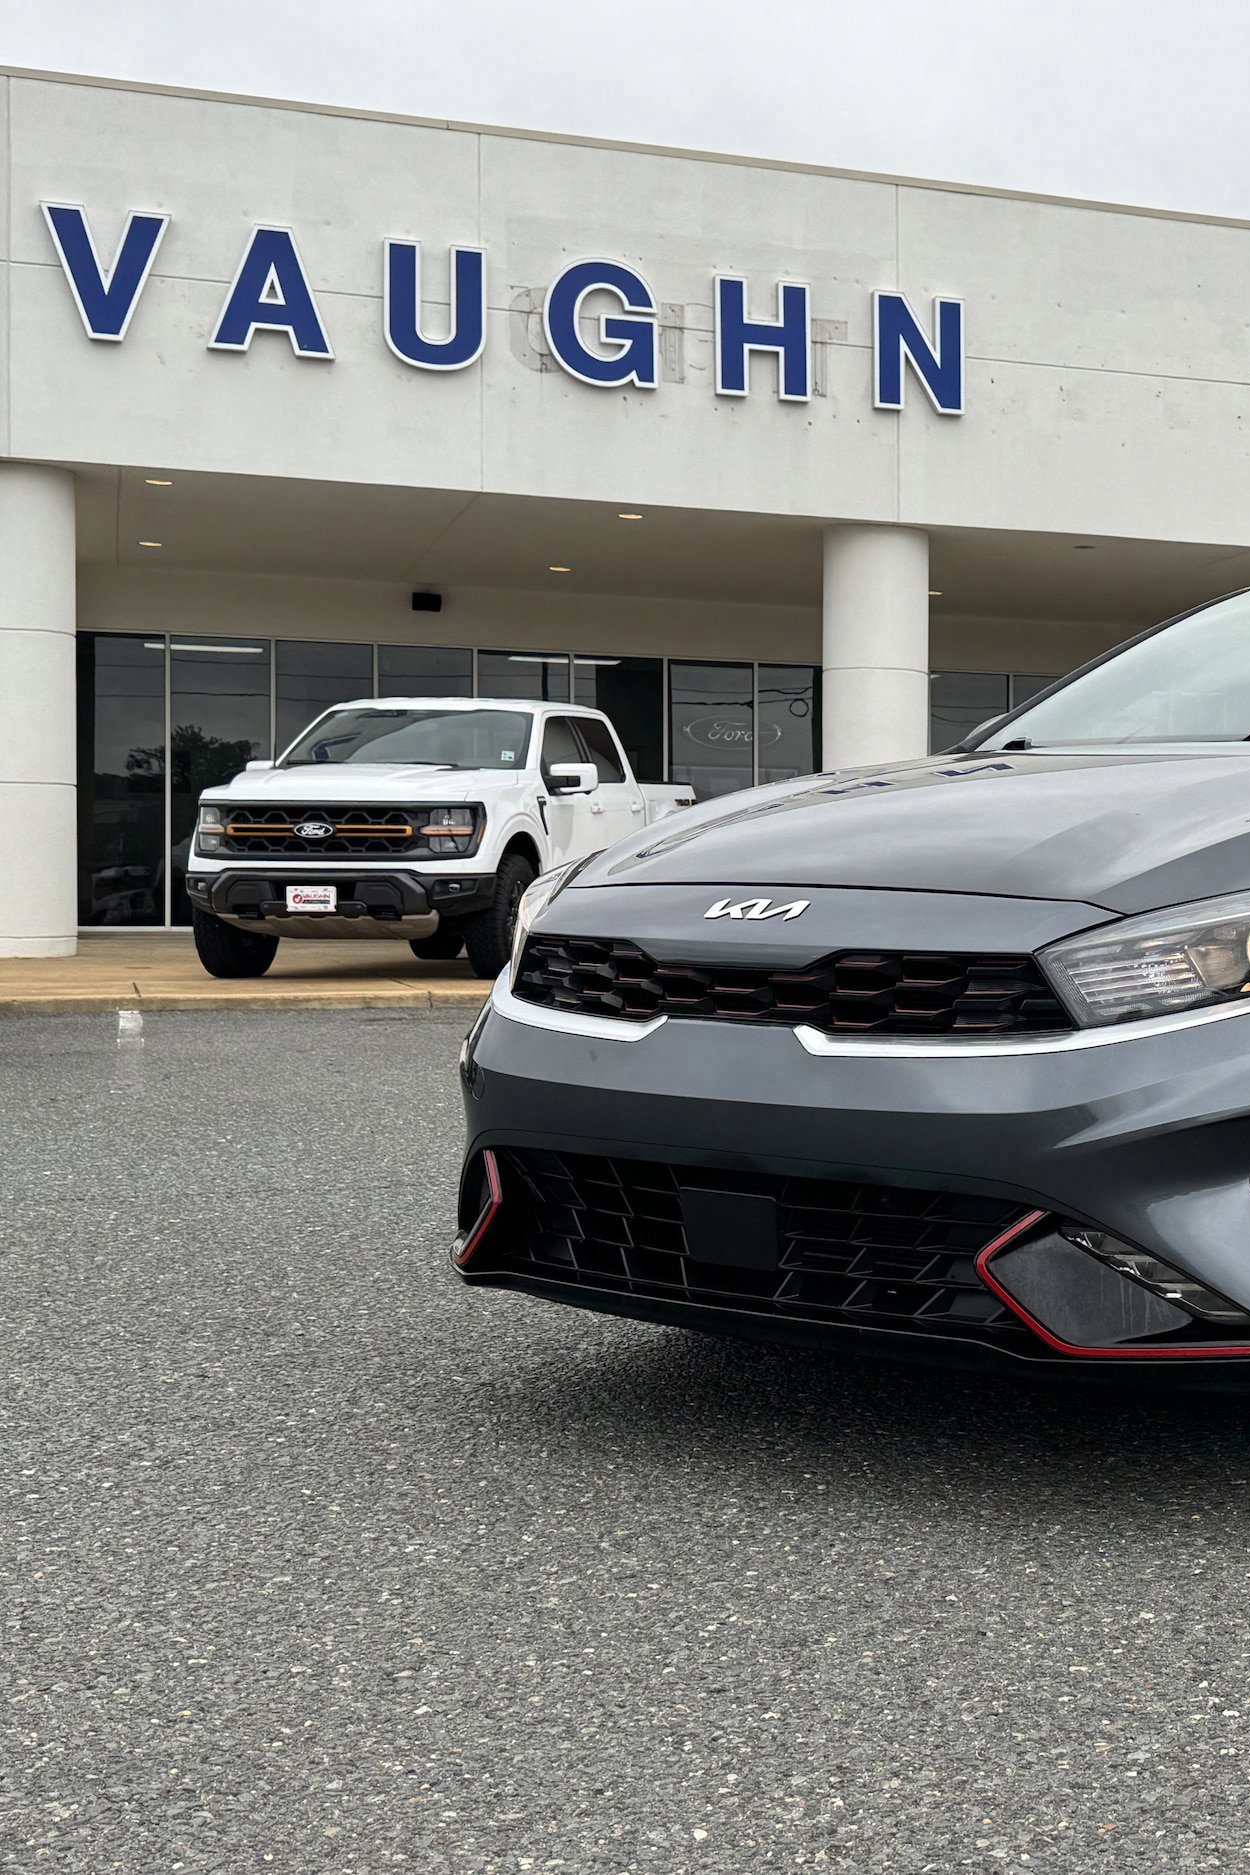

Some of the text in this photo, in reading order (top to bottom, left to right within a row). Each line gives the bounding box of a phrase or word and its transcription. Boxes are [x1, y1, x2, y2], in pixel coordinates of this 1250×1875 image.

[39, 201, 966, 417] VAUGHN
[301, 824, 326, 835] Ford
[703, 897, 811, 921] KIA
